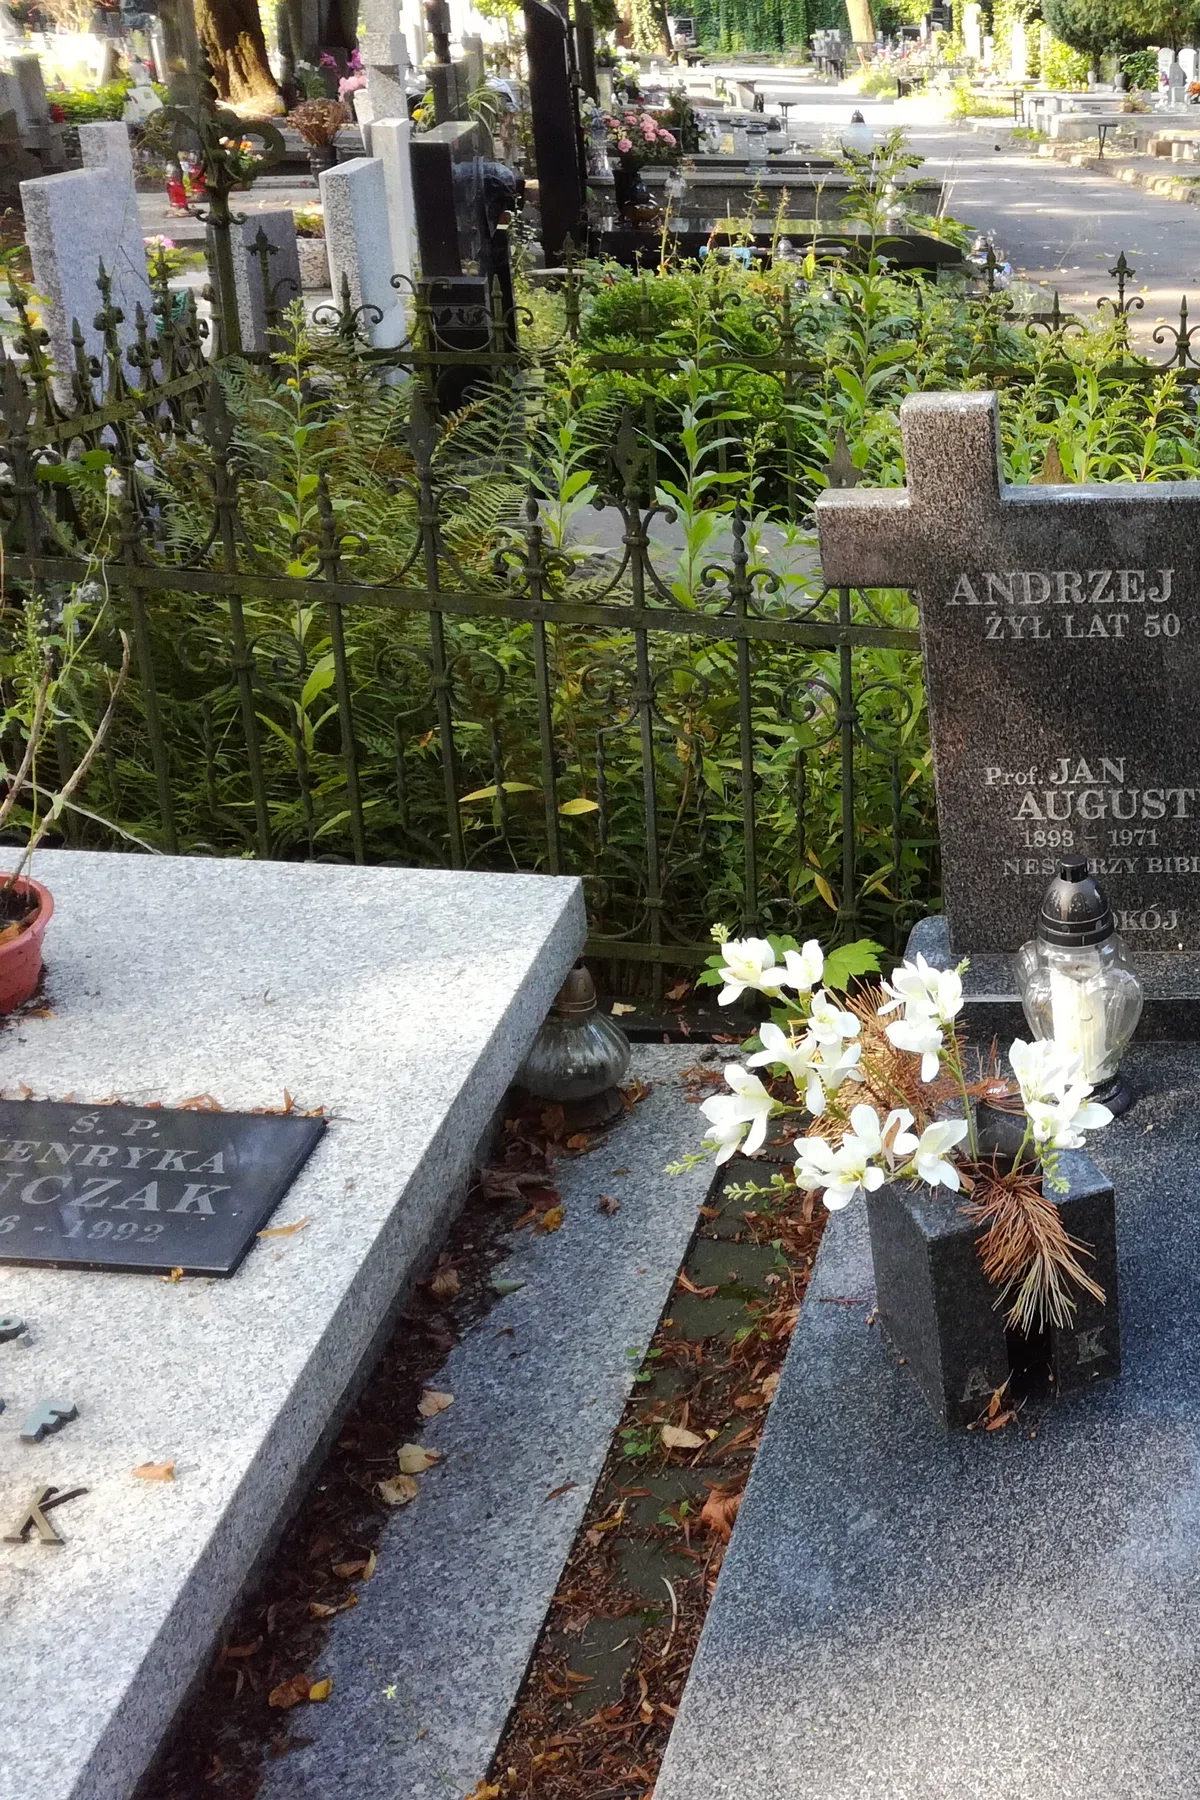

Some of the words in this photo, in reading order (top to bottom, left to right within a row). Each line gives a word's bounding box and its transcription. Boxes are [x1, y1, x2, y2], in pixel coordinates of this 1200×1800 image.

[946, 569, 1175, 606] ANDRZEJ
[986, 611, 1051, 640] ŻYŁ
[1063, 614, 1130, 638] LAT
[1144, 613, 1181, 638] 50
[984, 766, 1044, 786] Prof.
[1050, 757, 1126, 784] JAN
[1021, 830, 1074, 848] 1893
[1107, 829, 1160, 847] 1971
[1003, 857, 1140, 876] NESRZY
[1111, 903, 1178, 931] KÓJ
[69, 1111, 105, 1135] Ś.
[121, 1118, 161, 1138] P.
[0, 1139, 226, 1174] ENRYKA
[62, 1219, 165, 1243] 1992
